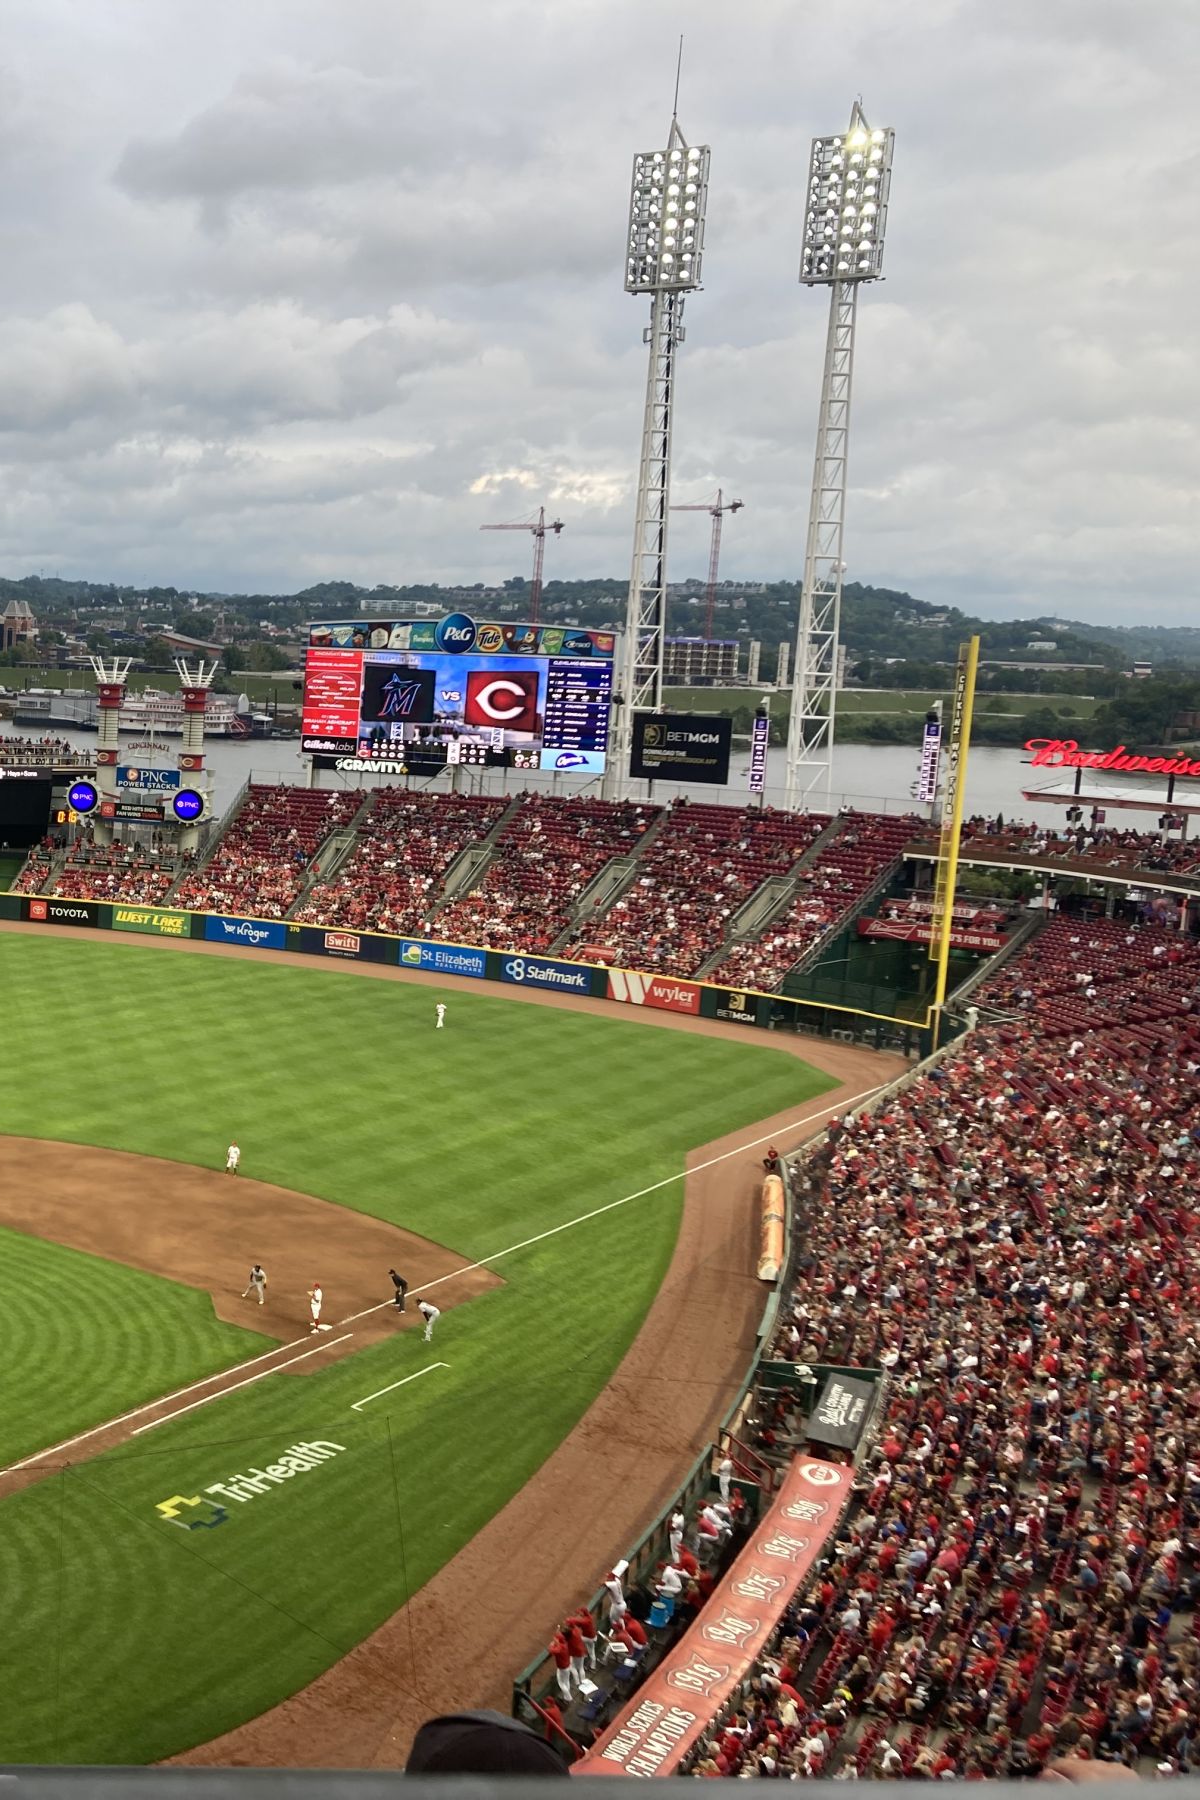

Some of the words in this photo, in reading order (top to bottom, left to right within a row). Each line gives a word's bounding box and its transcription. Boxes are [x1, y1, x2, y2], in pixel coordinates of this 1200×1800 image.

[443, 627, 473, 641] P&G
[478, 629, 501, 647] Tide
[442, 690, 460, 701] VS
[667, 731, 720, 744] BETMGM
[140, 770, 169, 783] PNC
[118, 780, 145, 788] POWER
[146, 781, 176, 790] STACKS
[184, 801, 199, 809] PNC
[50, 907, 89, 919] TOYOTA
[115, 910, 151, 925] WEST
[152, 915, 185, 928] LAKE
[160, 926, 182, 934] TIRES
[236, 922, 270, 943] Kroger
[328, 937, 357, 948] Swift
[964, 935, 982, 944] FOR
[434, 962, 482, 973] HEALTHCARE
[435, 952, 483, 969] Elizabeth
[526, 965, 587, 987] Staffmark
[653, 985, 695, 1003] wyler
[717, 1008, 755, 1023] BETMGM
[204, 1440, 347, 1503] TriHealth
[738, 1575, 780, 1601] 1975
[708, 1618, 751, 1645] 1940
[674, 1663, 722, 1693] 1919
[601, 1729, 641, 1763] WORLD
[626, 1700, 665, 1733] SERIES
[625, 1706, 696, 1777] CHAMPIONS
